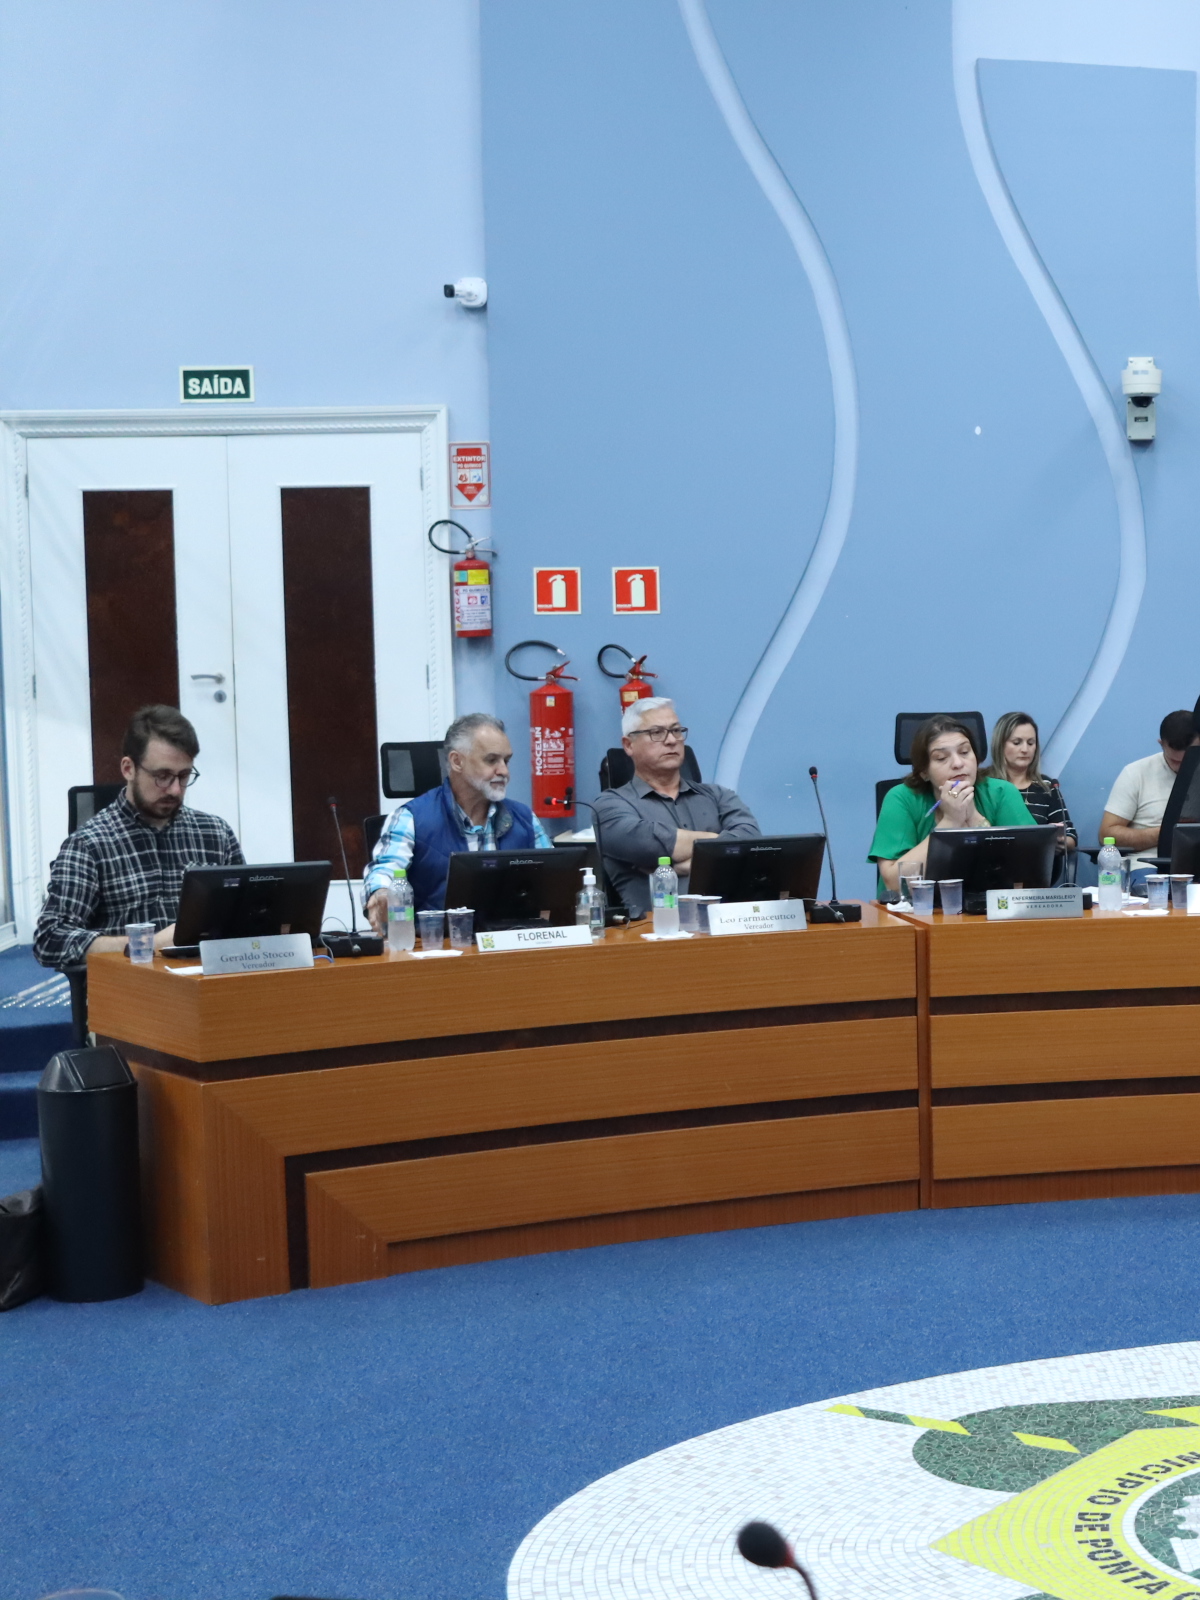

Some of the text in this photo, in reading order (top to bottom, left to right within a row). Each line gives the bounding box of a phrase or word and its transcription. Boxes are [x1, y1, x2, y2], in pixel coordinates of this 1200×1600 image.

[188, 374, 246, 395] SAÍDA
[534, 726, 543, 776] MOCELIN
[517, 930, 568, 942] FLORENAL
[220, 951, 295, 963] Geraldo Stocco
[241, 961, 276, 970] Vereador
[1074, 1512, 1112, 1533] DE
[1077, 1538, 1171, 1595] PONTA
